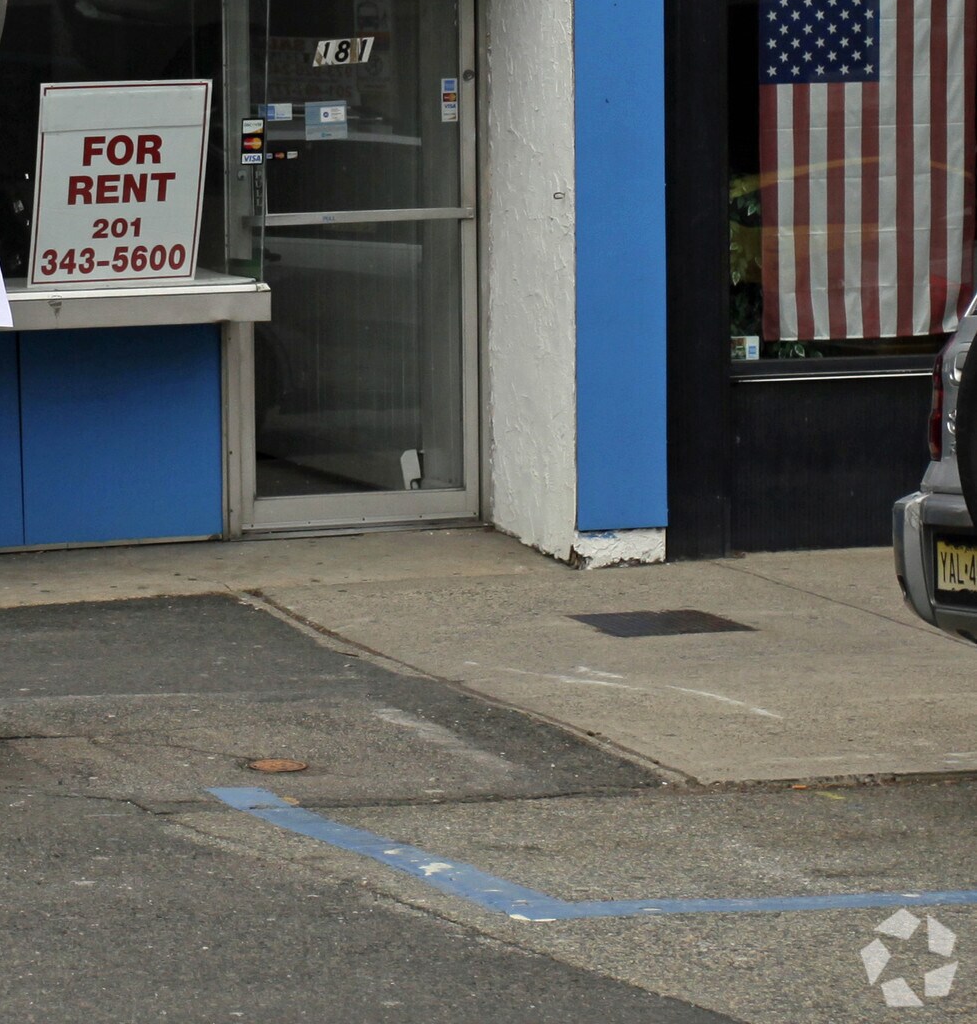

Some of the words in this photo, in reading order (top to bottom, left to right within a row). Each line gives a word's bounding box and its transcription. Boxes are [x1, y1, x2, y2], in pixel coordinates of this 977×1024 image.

[323, 38, 368, 62] 181
[82, 134, 163, 166] FOR
[67, 172, 176, 205] RENT
[92, 217, 142, 239] 201
[40, 243, 186, 276] 343-5600
